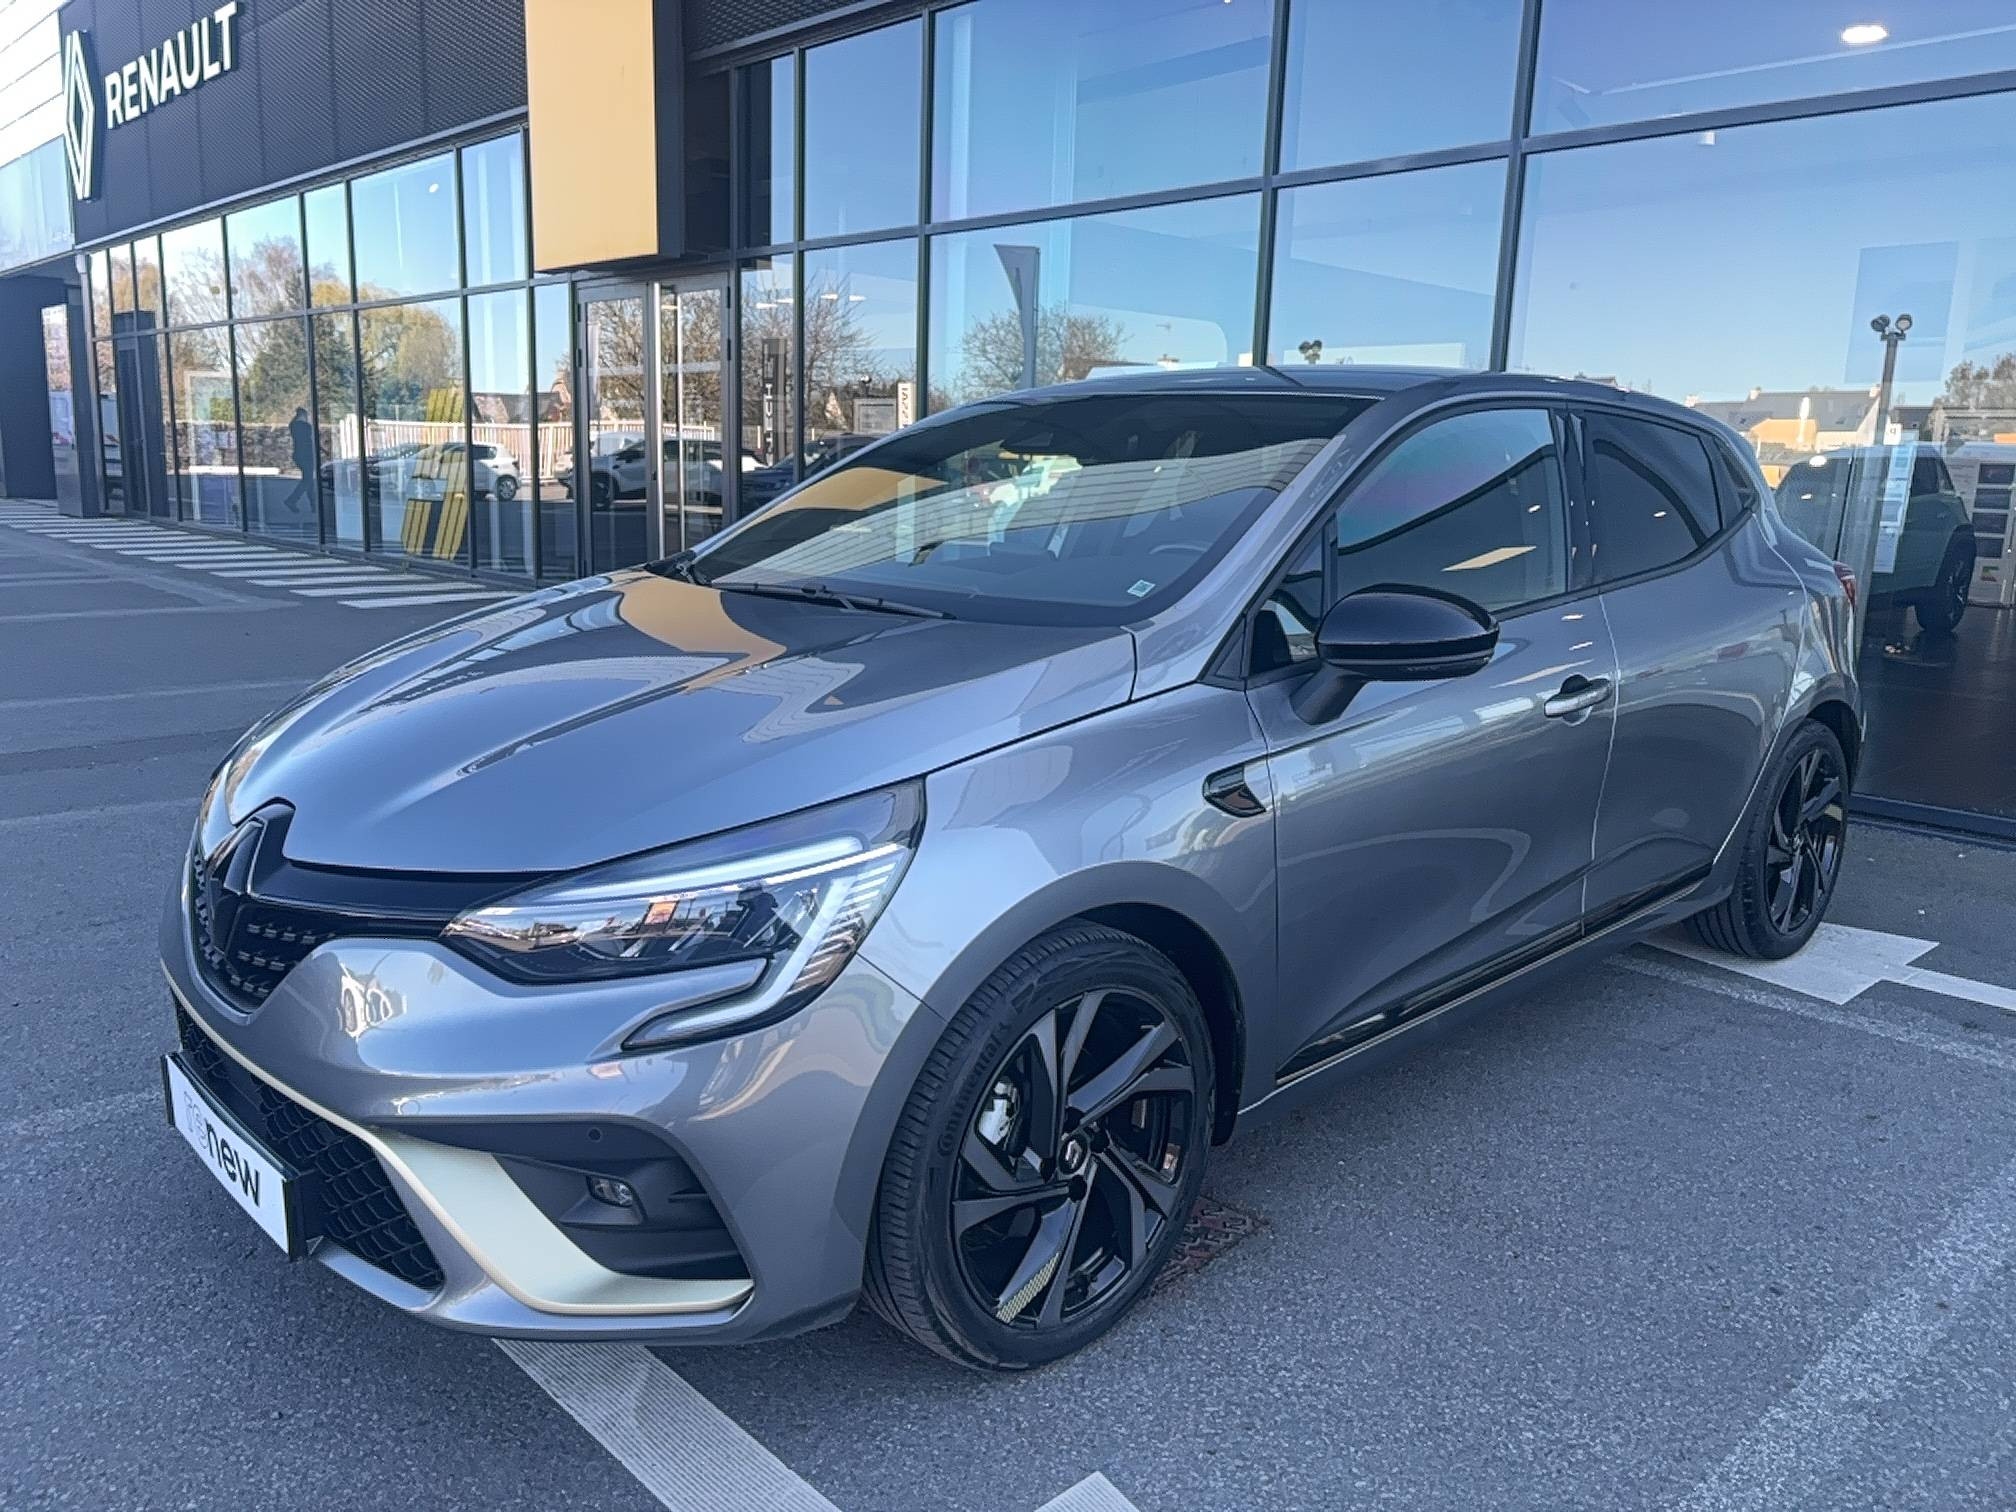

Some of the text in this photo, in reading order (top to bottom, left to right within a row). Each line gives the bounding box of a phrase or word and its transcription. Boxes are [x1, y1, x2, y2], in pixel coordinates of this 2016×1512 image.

[104, 0, 238, 130] RENAULT
[183, 1091, 260, 1208] renew
[937, 1033, 1002, 1156] Continental
